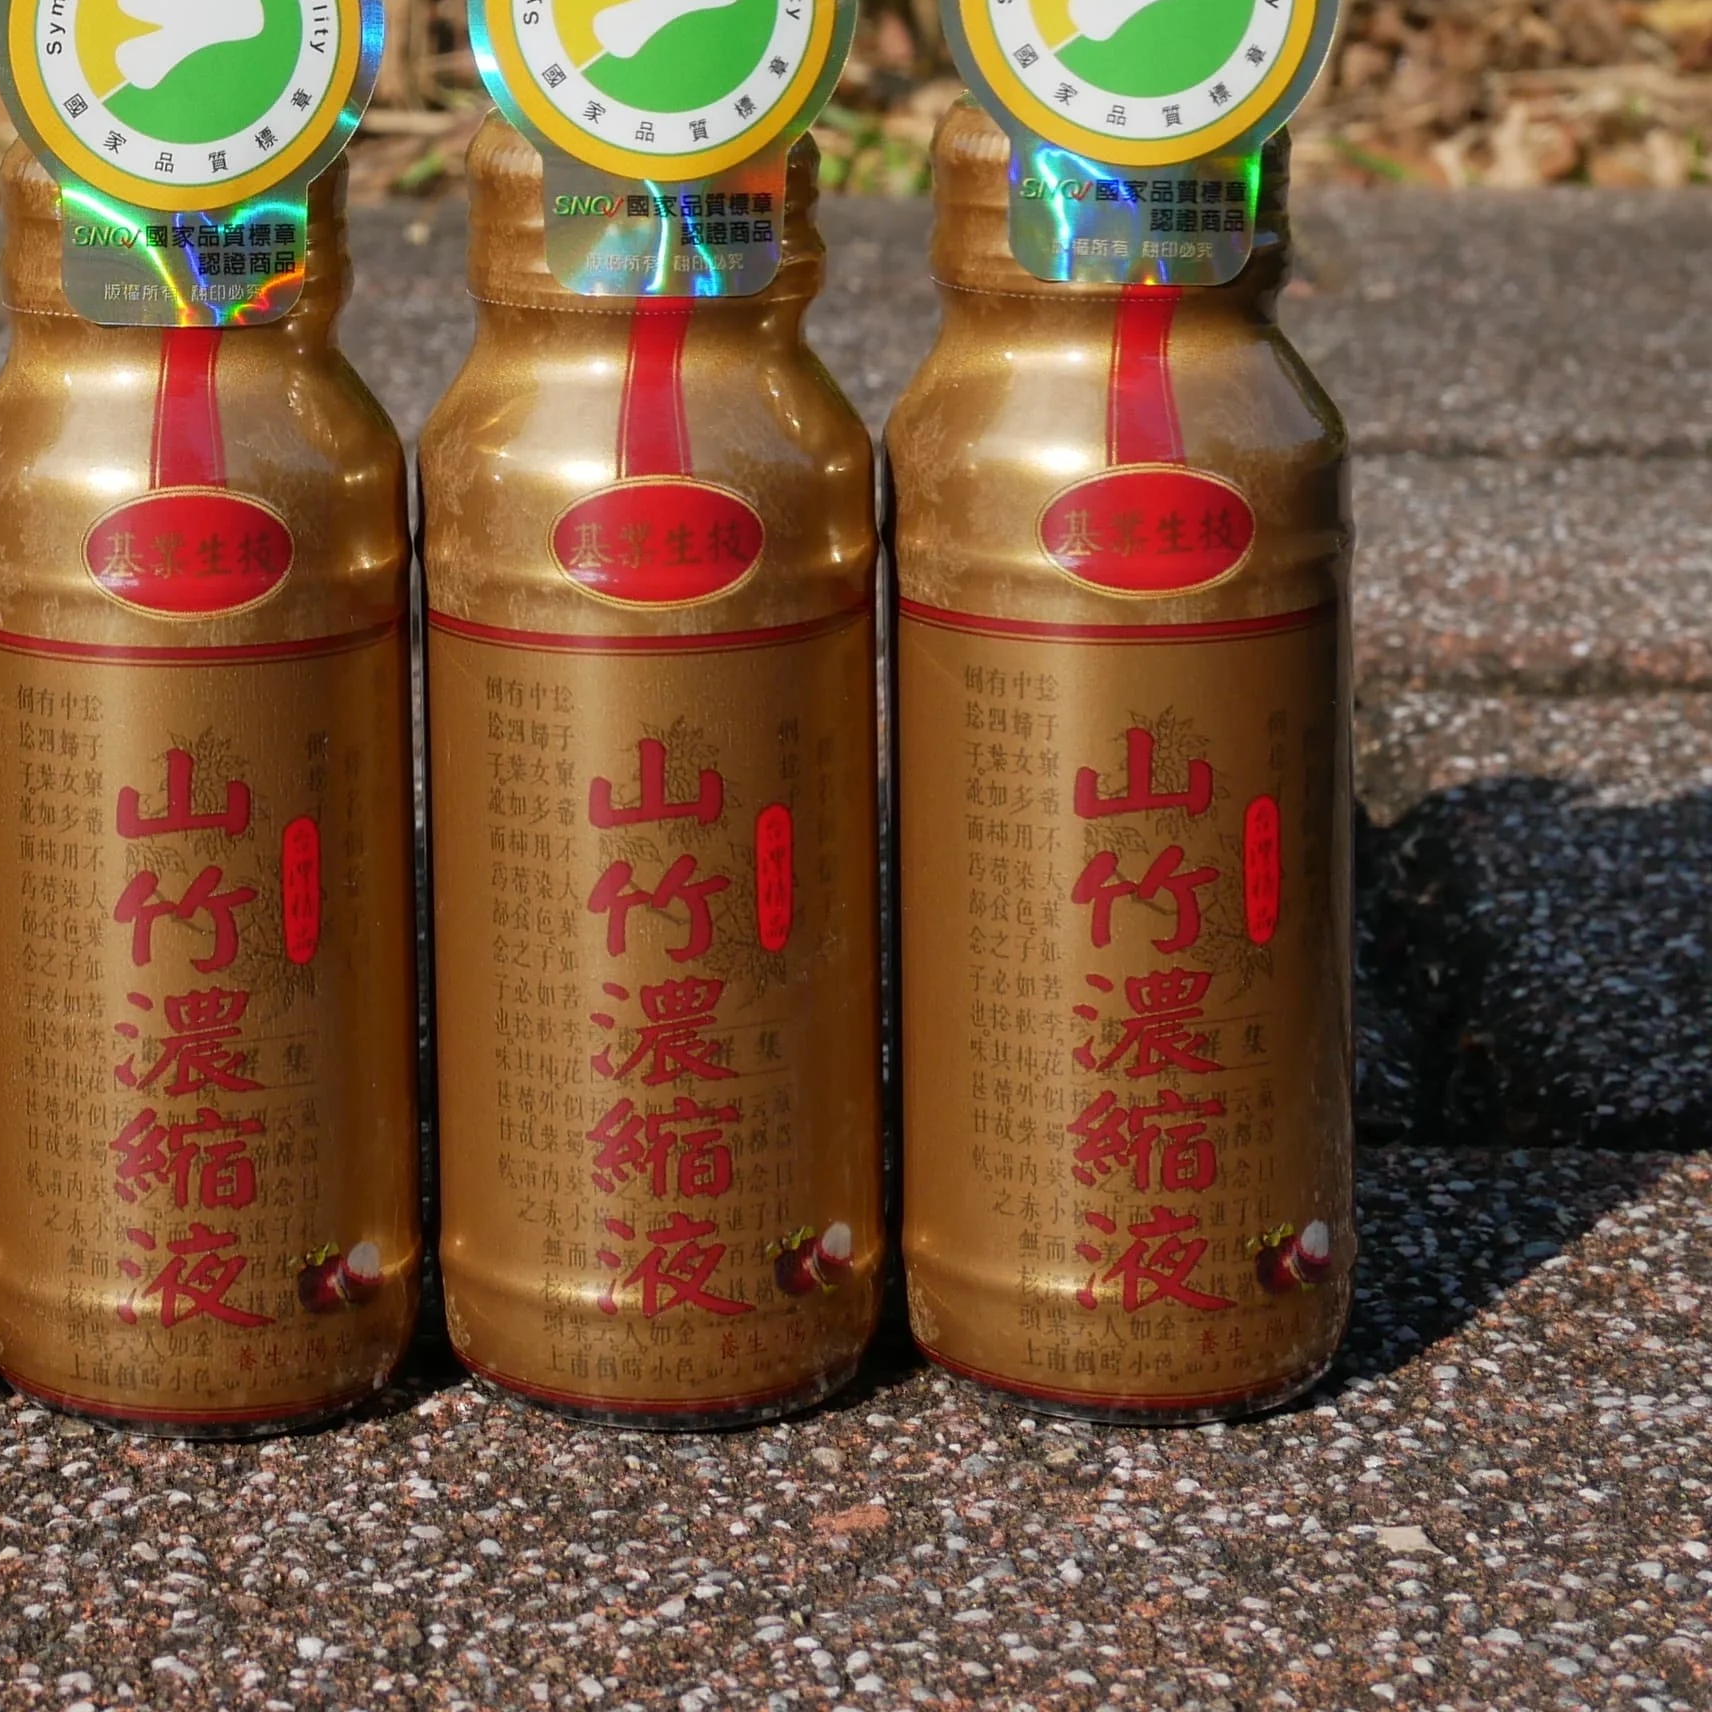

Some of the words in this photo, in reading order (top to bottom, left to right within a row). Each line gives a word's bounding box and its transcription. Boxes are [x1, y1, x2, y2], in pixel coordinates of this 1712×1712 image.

[627, 193, 773, 218] 國家品質標章
[1150, 208, 1245, 233] 認證商品
[146, 224, 296, 248] 國家品質標章
[680, 221, 773, 246] 認證商品
[1052, 240, 1128, 257] 權所有
[198, 251, 296, 277] 認證商品
[587, 738, 756, 1318] 山竹濃縮液
[1067, 728, 1237, 1314] 山竹濃縮液
[109, 748, 277, 1328] 山竹濃縮液
